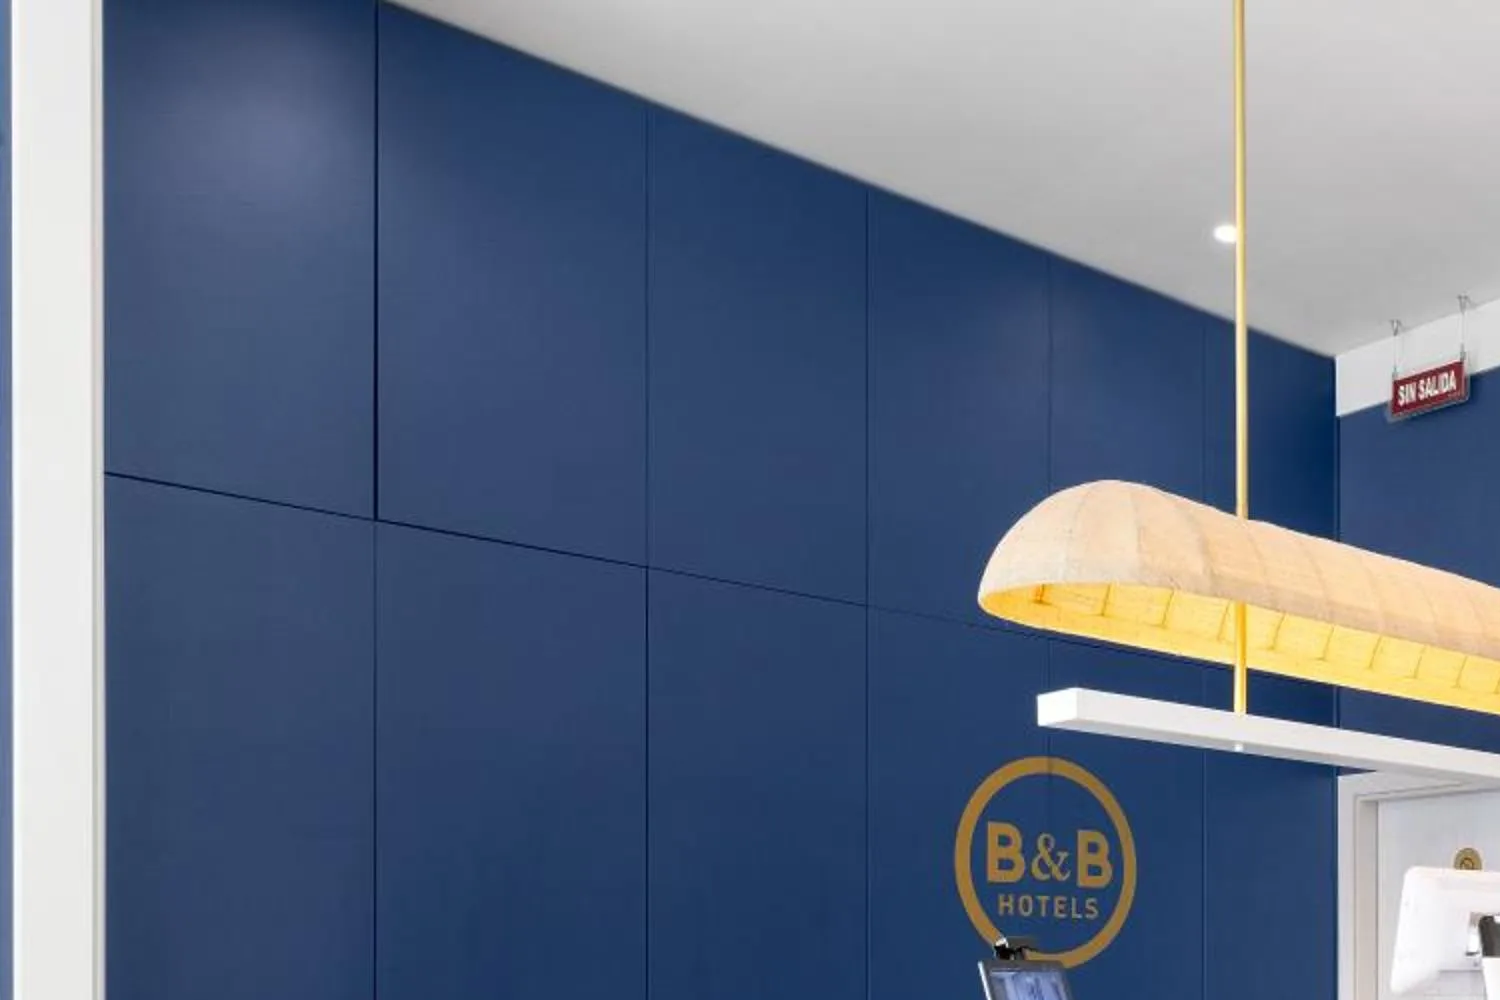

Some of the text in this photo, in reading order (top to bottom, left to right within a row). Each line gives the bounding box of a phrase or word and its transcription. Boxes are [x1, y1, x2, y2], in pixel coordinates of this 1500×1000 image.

[1398, 370, 1457, 406] SIN SALIDA
[986, 820, 1113, 888] B&B
[998, 894, 1099, 919] HOTELS
